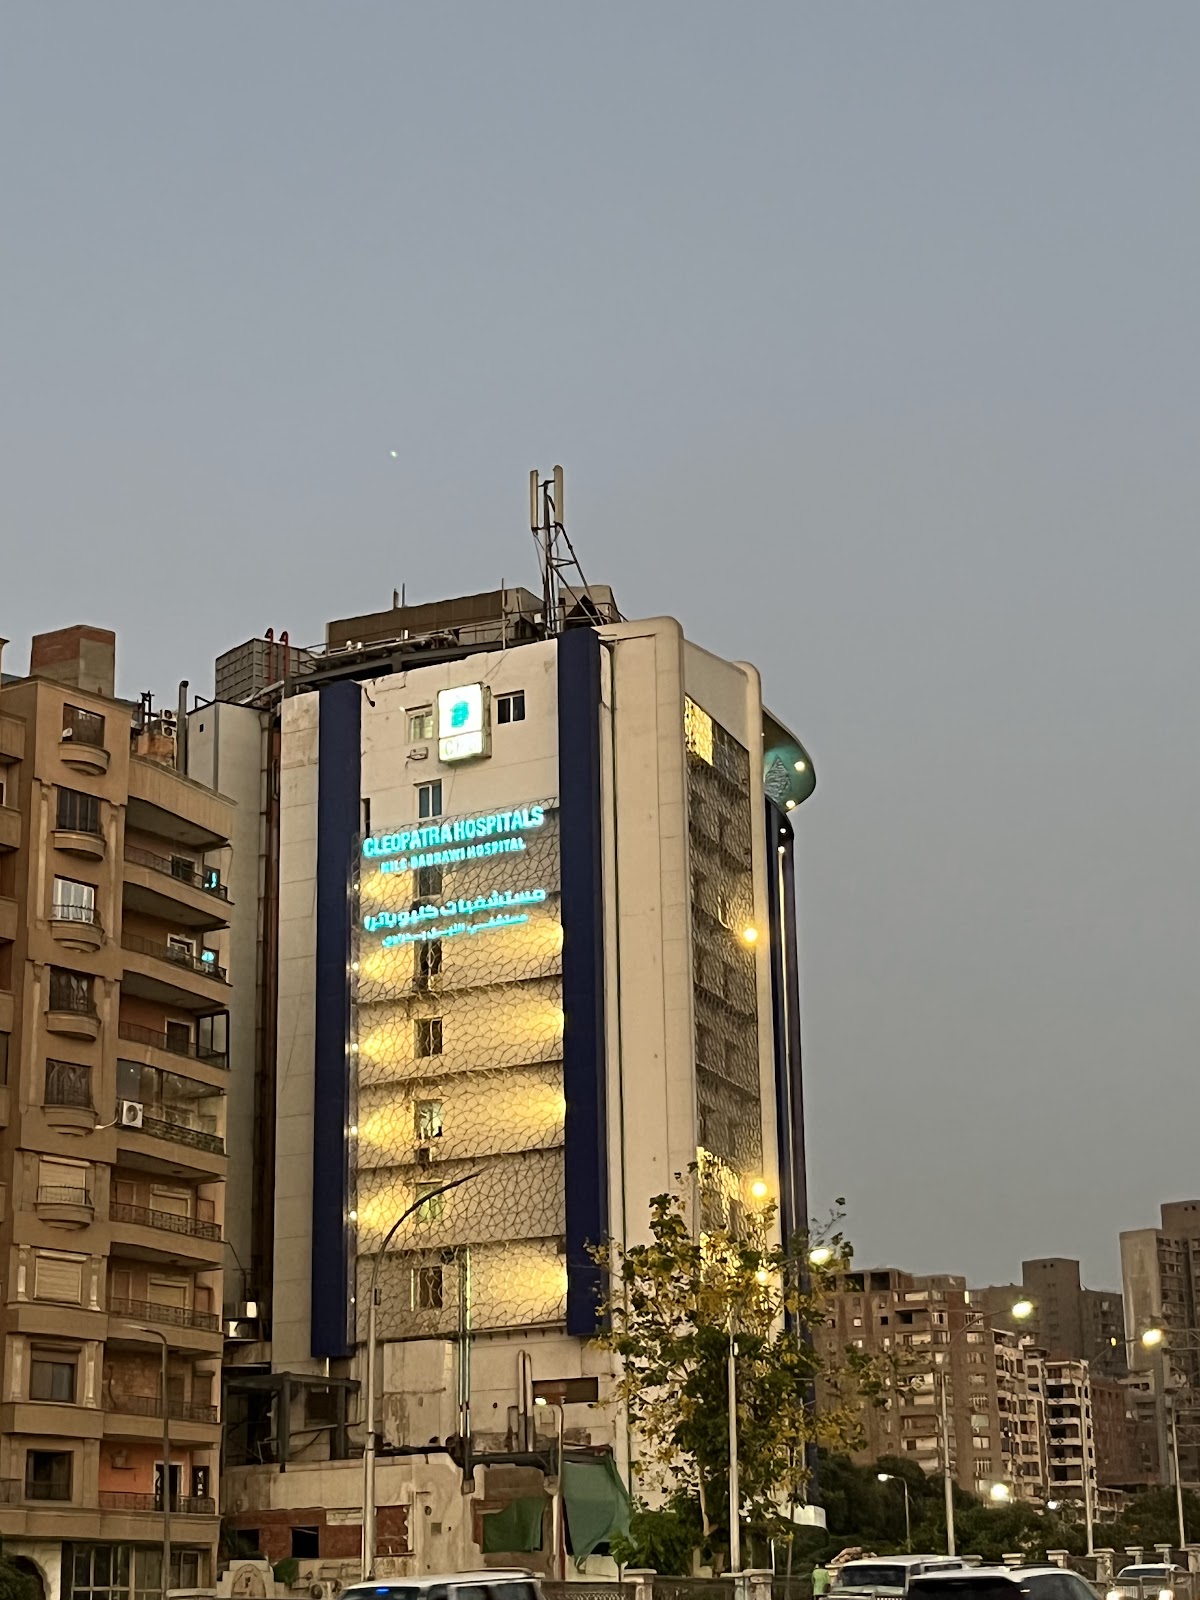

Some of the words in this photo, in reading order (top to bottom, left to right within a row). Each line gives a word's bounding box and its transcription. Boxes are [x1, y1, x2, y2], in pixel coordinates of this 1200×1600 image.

[363, 825, 453, 858] CLEOPATRA
[453, 806, 544, 841] HOSPITALS
[466, 837, 526, 859] HOSPITAL
[439, 888, 546, 917] مستشفيات
